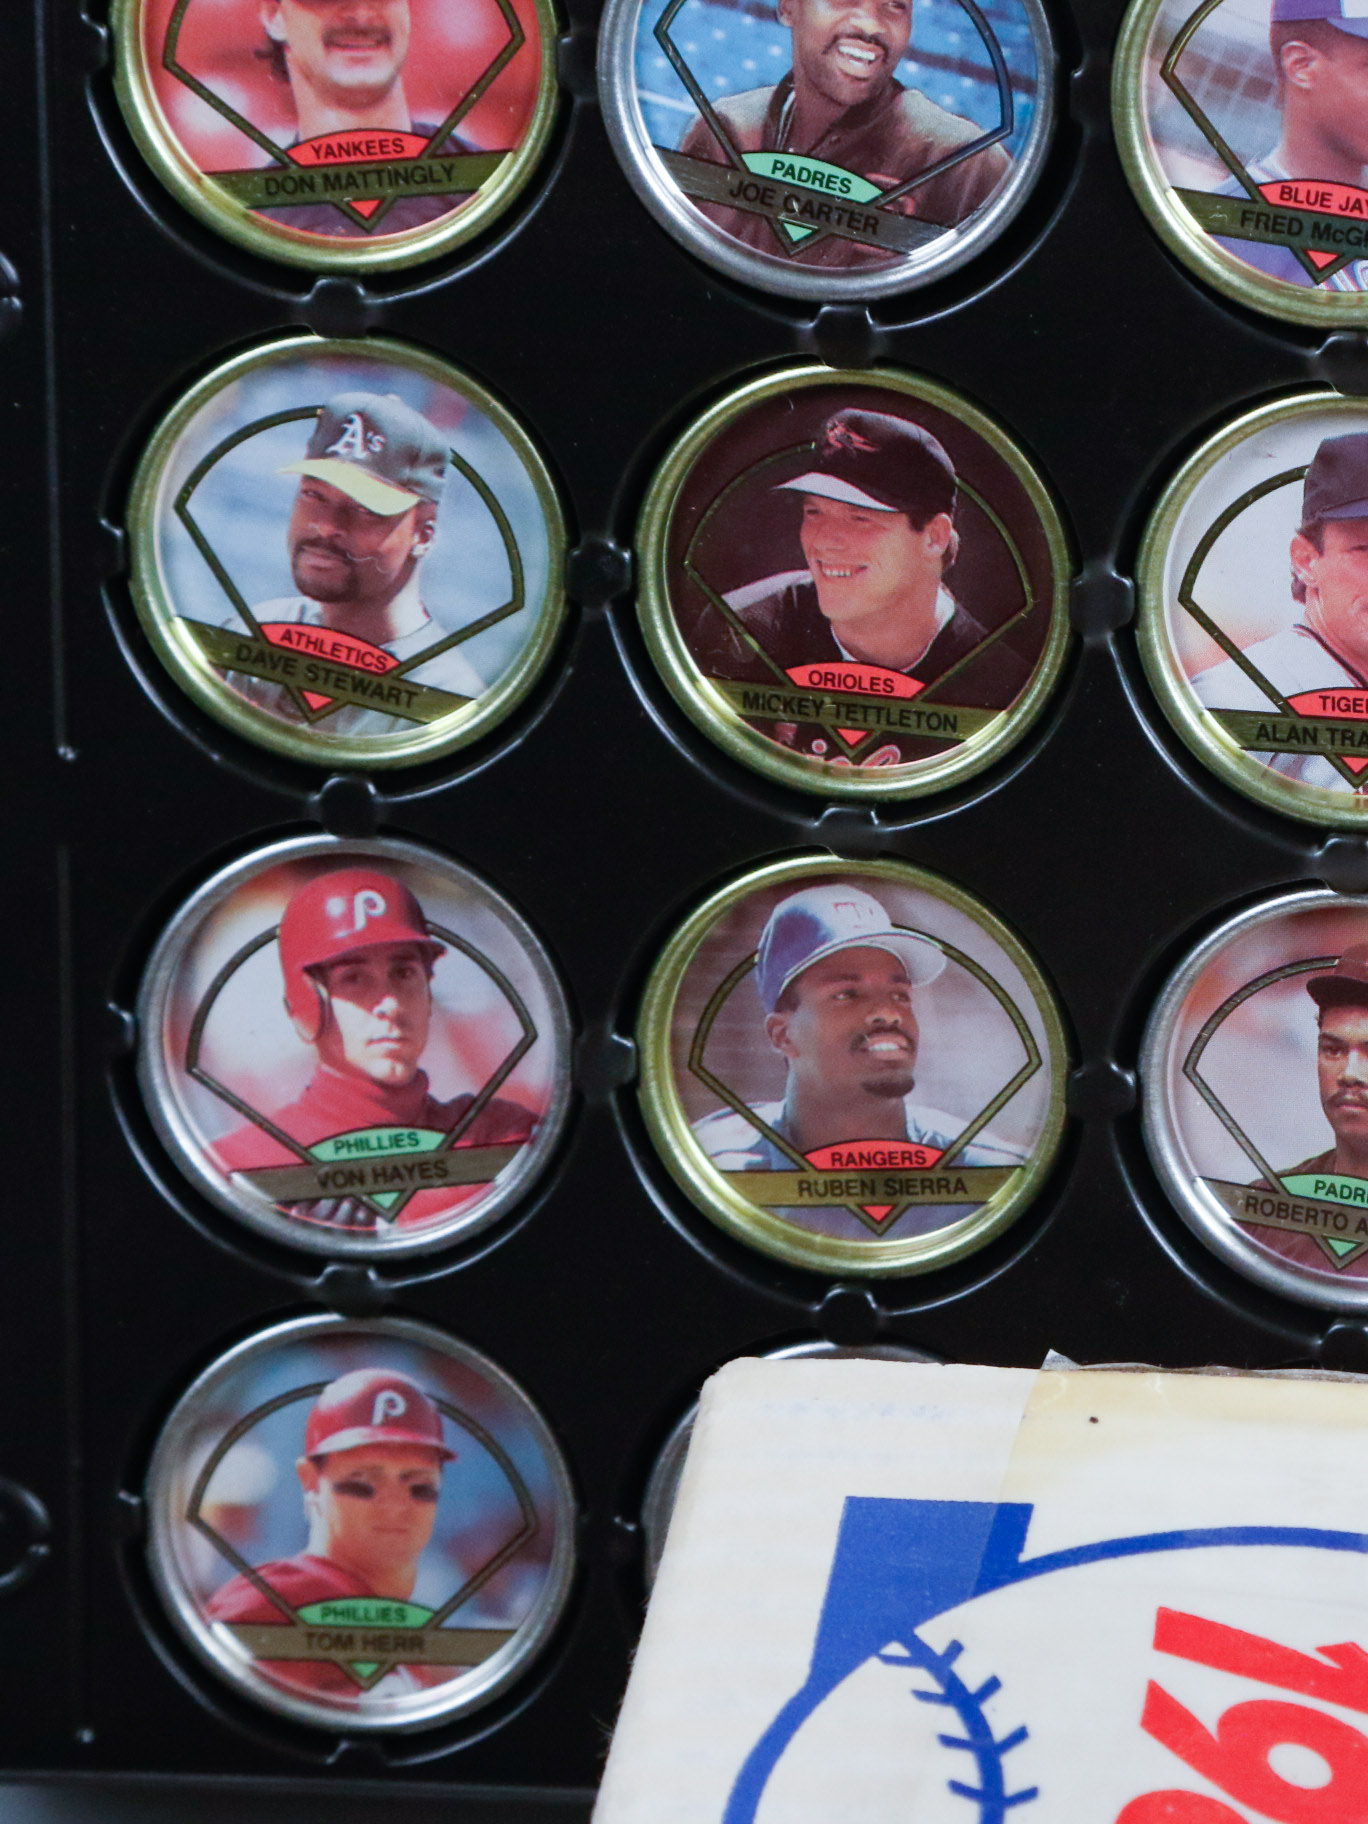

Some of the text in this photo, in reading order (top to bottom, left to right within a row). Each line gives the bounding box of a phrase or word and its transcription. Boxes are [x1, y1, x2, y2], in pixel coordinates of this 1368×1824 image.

[311, 137, 405, 160] YANKEES
[265, 163, 455, 197] DON MATTINGLY
[771, 159, 852, 195] PADRES
[729, 179, 879, 236] JOE CARTER
[1279, 184, 1332, 210] BLUE
[1240, 210, 1304, 238] FRED
[325, 412, 386, 459] A's
[279, 628, 389, 671] ATHLETICS
[235, 644, 419, 709] DAVE STEWART
[808, 670, 895, 694] ORIOLES
[742, 690, 958, 732] MICKEY TETTLETON
[1255, 722, 1318, 746] ALAN
[333, 1132, 421, 1155] PHILLIES
[830, 1149, 927, 1167] RANGERS
[316, 1159, 450, 1191] VON HAYES
[797, 1176, 968, 1197] RUBEN SIERRA
[1244, 1195, 1349, 1232] ROBERTO
[371, 1390, 406, 1426] P
[320, 1605, 407, 1624] PHILLIES
[305, 1632, 426, 1653] TOM HERR
